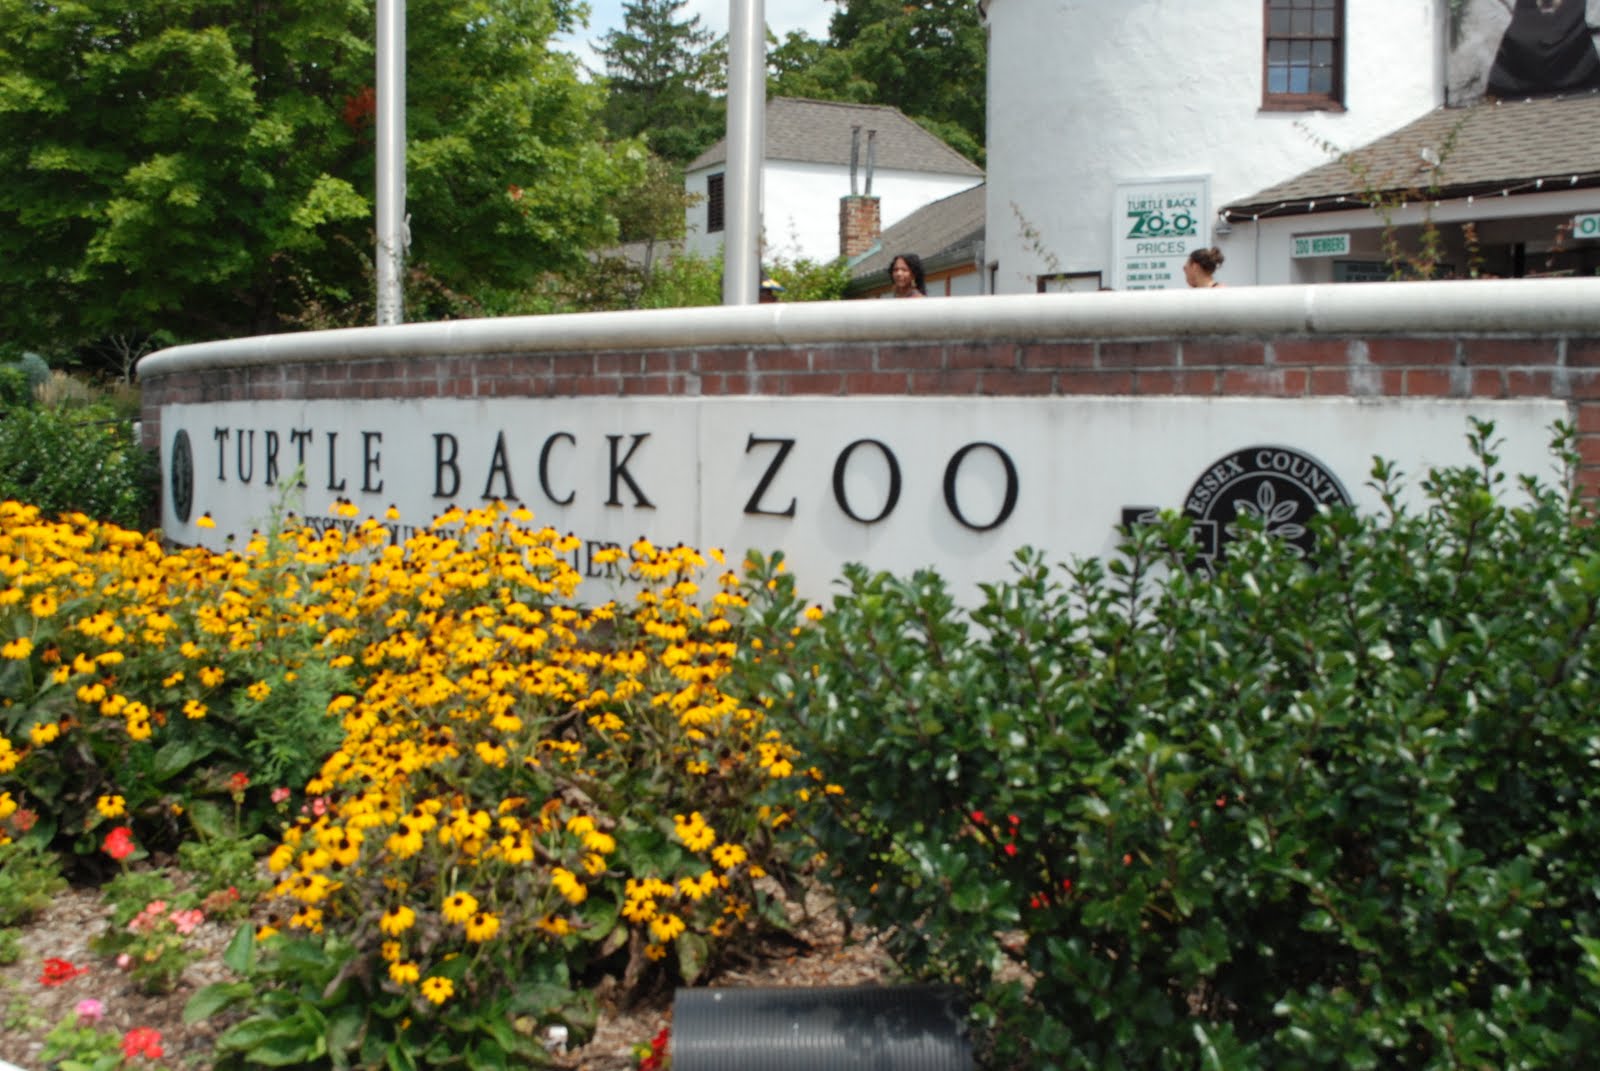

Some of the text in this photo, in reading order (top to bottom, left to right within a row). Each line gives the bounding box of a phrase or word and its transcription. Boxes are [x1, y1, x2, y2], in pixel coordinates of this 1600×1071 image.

[1127, 198, 1196, 210] TURTLE BACK
[1136, 241, 1185, 254] PRICES
[1295, 236, 1345, 255] ZOO MEMBERS
[213, 426, 1020, 533] TURTLE BACK ZOO
[1187, 450, 1342, 516] ESSEX COUNT
